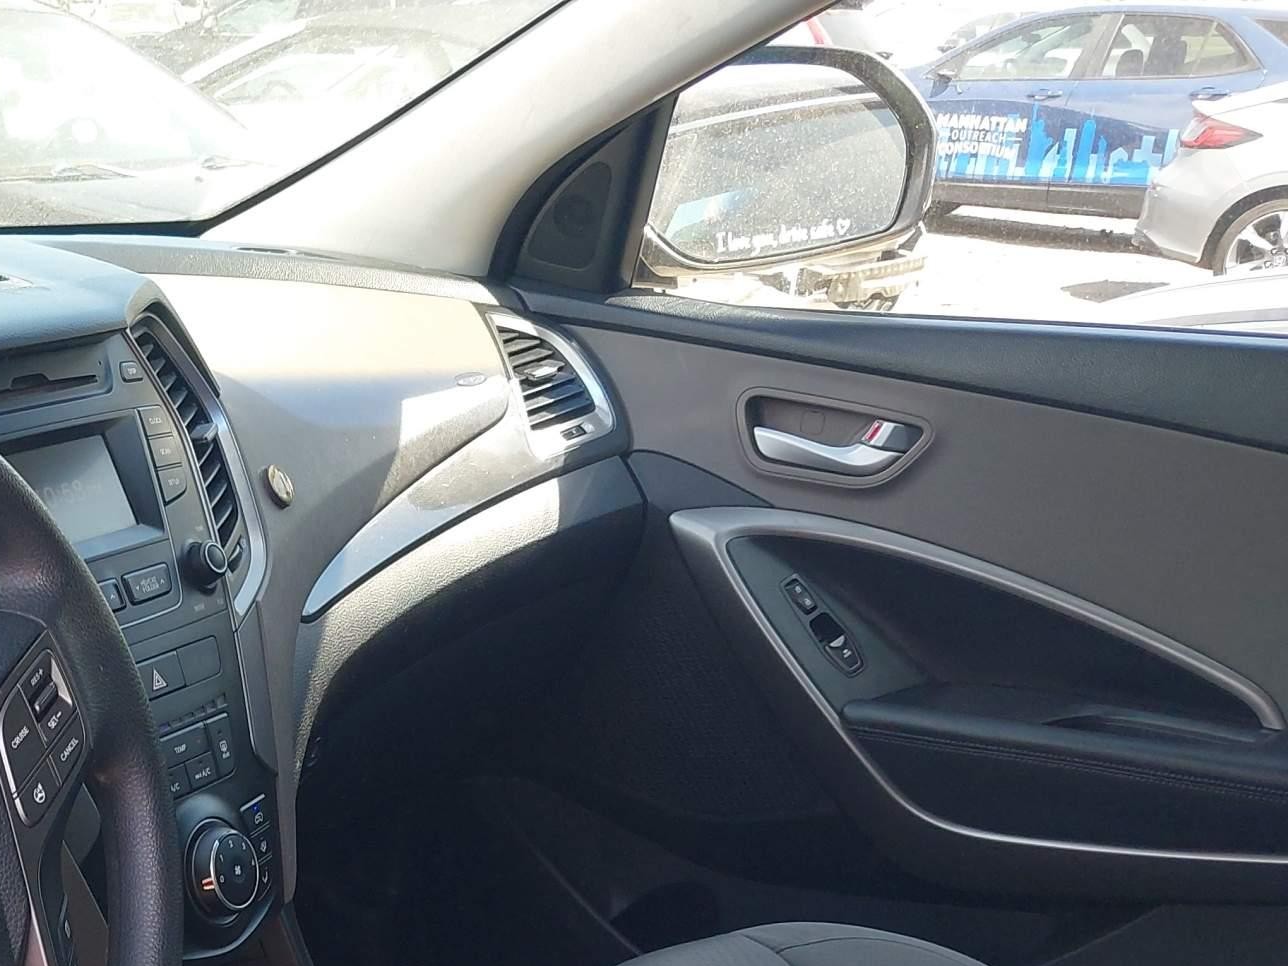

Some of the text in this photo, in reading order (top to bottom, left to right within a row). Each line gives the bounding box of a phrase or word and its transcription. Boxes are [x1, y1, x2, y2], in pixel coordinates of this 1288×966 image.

[937, 113, 1028, 133] MANHATTAN
[951, 129, 1006, 144] OUTREACH
[11, 725, 30, 749] CRUISE
[60, 737, 79, 762] CANCEL
